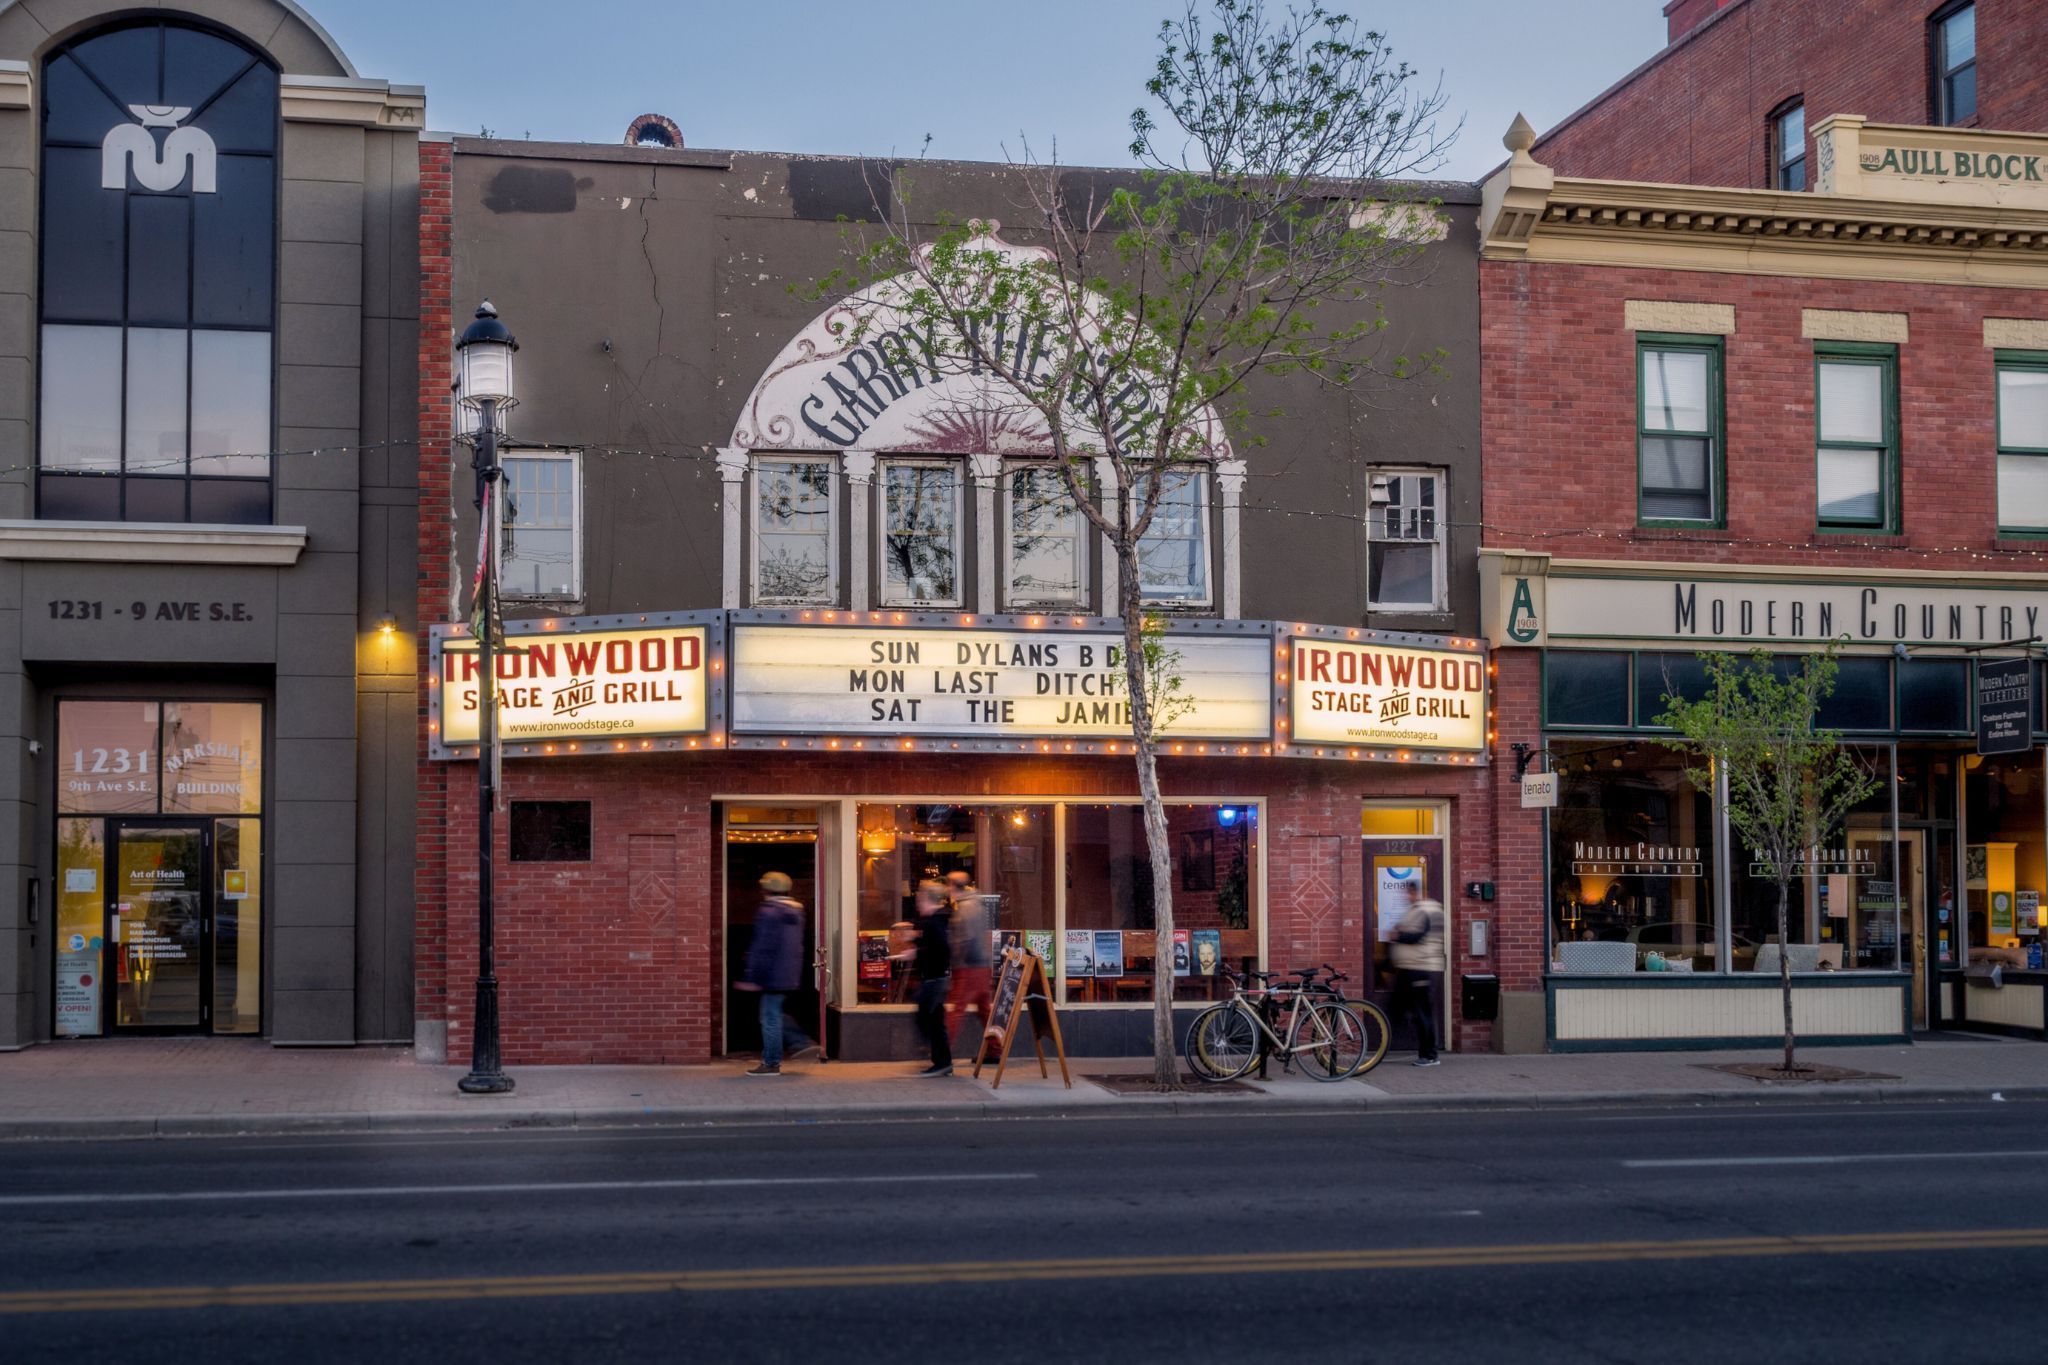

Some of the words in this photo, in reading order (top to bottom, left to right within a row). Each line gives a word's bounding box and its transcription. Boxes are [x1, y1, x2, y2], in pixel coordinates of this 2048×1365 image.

[1859, 153, 1880, 164] 1908
[1862, 148, 1949, 177] AULL
[1954, 151, 2042, 182] BLOCK
[48, 601, 103, 620] 1231
[130, 601, 147, 621] 9
[155, 602, 200, 621] AVE
[209, 602, 253, 621] S.E.
[1675, 583, 1832, 637] MODERN
[1861, 588, 2039, 641] COUNTRY
[445, 636, 700, 682] IRONWOOD
[870, 640, 920, 664] SUN
[957, 642, 1059, 667] DYLANS
[1079, 645, 1093, 668] B
[1297, 647, 1482, 692] IRONWOOD
[1980, 676, 2002, 690] MODERN
[2003, 673, 2028, 687] COUNTRY
[464, 687, 543, 711] SAGE
[553, 684, 594, 711] AND
[603, 679, 682, 704] GRILL
[849, 669, 905, 692] MON
[934, 671, 999, 694] LAST
[1036, 672, 1115, 696] DITCH
[871, 698, 921, 722] SAT
[966, 700, 1015, 723] THE
[1056, 702, 1152, 725] JAMIE
[1311, 690, 1373, 714] STAGE
[1380, 697, 1410, 718] AND
[1416, 697, 1470, 719] GRILL
[509, 718, 635, 733] www.ironwoodstage.ca
[1346, 726, 1438, 741] www.ironwoodstage.ca
[73, 748, 149, 773] 1231
[68, 780, 91, 792] 9th
[96, 780, 123, 792] Ave
[127, 780, 152, 792] S.E.
[1524, 781, 1551, 795] tenato
[1384, 841, 1416, 853] 1227
[1575, 841, 1630, 860] MODERN
[1638, 842, 1700, 860] COUNTRY
[130, 870, 144, 878] Art
[145, 870, 155, 878] of
[156, 870, 185, 878] Health
